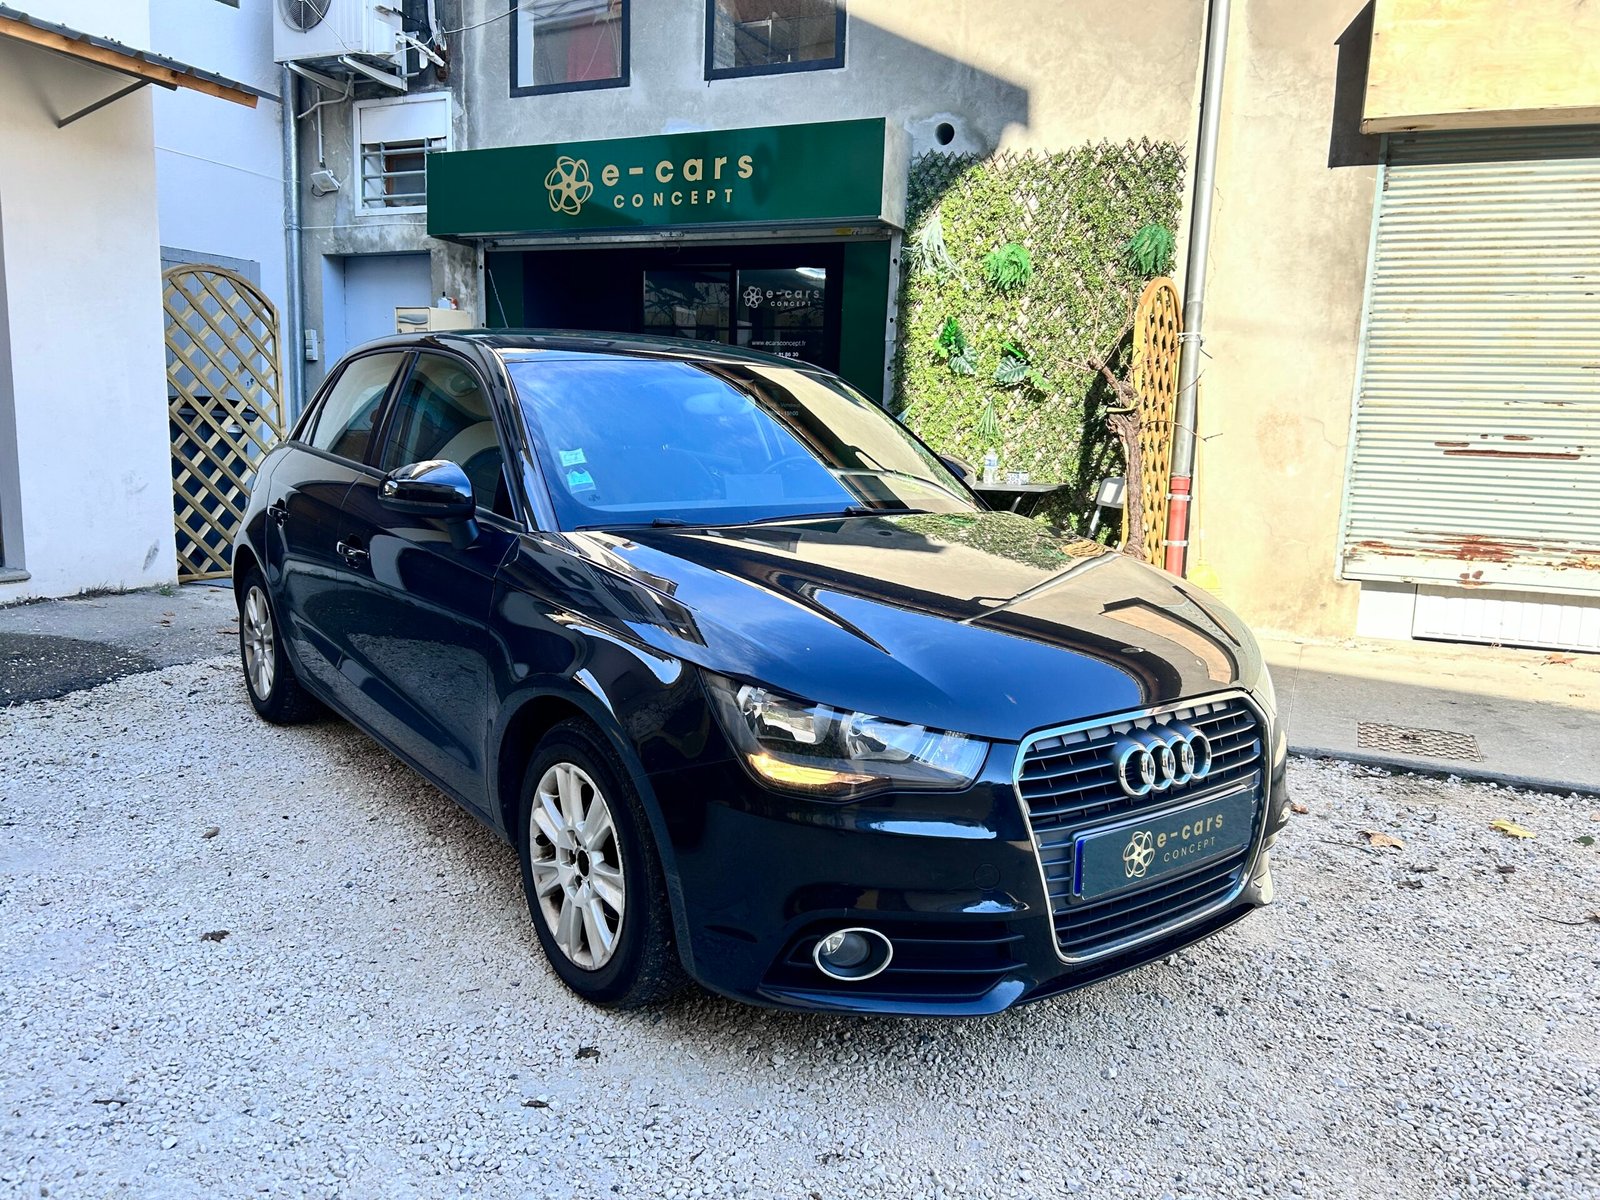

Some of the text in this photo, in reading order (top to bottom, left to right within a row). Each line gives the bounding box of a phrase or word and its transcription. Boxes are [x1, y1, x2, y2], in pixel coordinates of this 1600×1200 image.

[601, 155, 753, 187] e-cars
[613, 188, 733, 208] CONCEPT
[766, 289, 820, 299] e-cars
[1157, 814, 1223, 848] e-cars
[1164, 836, 1216, 863] CONCEPT
